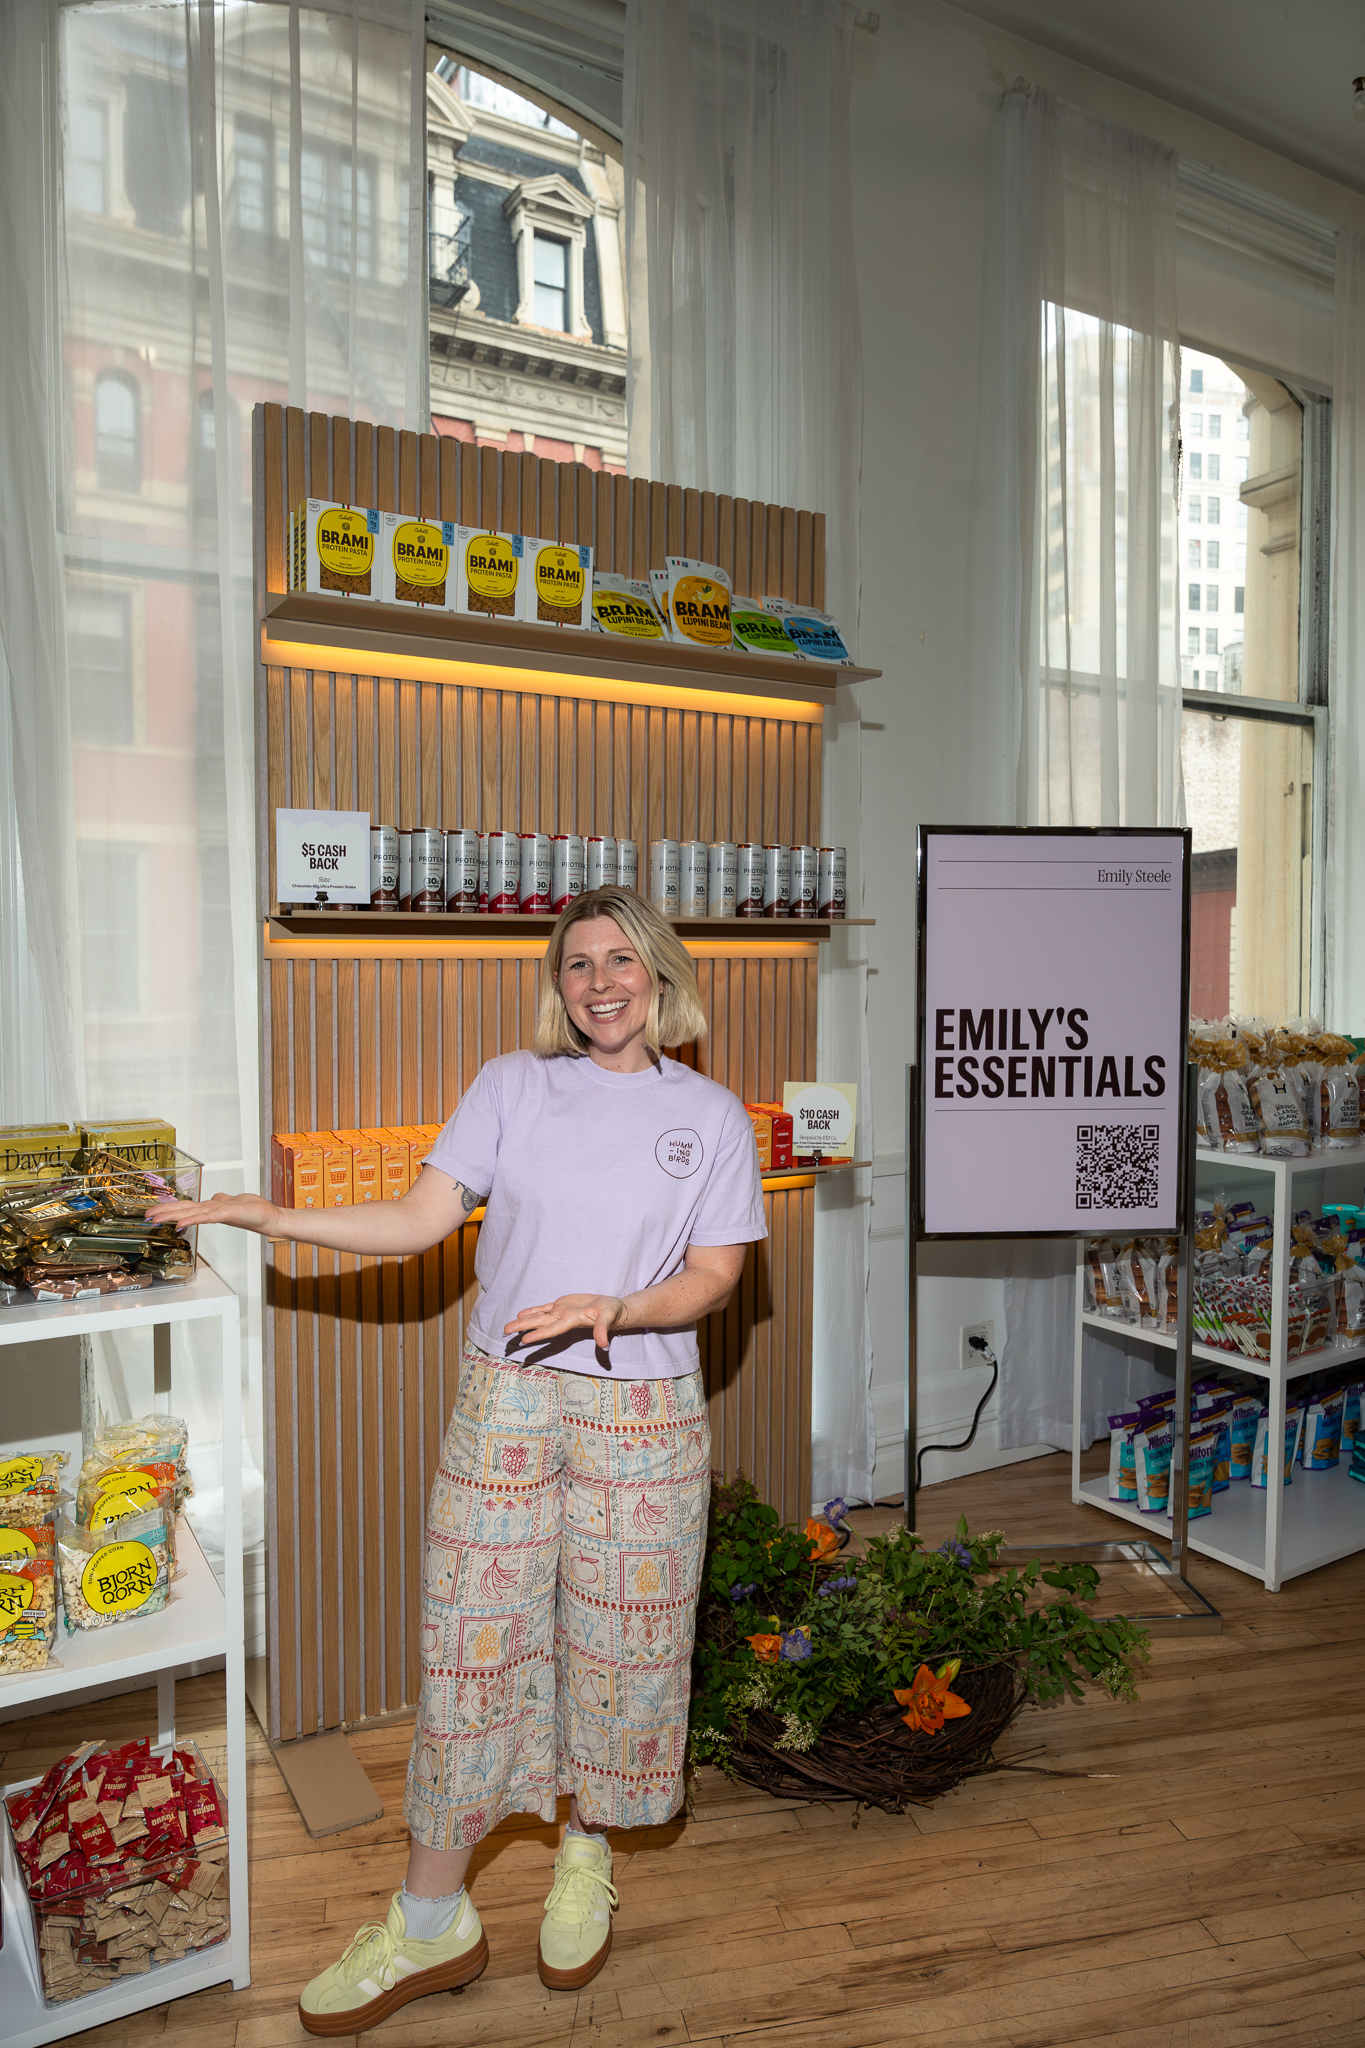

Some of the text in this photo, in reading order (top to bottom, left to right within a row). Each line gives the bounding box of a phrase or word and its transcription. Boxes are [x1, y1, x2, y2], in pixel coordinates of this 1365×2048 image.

[321, 529, 369, 550] BRAMI
[322, 543, 368, 557] PROTEIN PASTA
[397, 542, 444, 561] BRAMI
[398, 555, 442, 568] PROTEIN PASTA
[470, 555, 513, 573] BRAMI
[470, 568, 512, 579] PROTEIN PASTA
[539, 565, 580, 583] BRAMI
[540, 578, 563, 587] PROTEIN
[597, 604, 656, 620] BRAM
[675, 601, 730, 621] BRAM
[607, 615, 661, 627] LUPINI BEANS
[682, 617, 709, 627] LUPINI
[735, 623, 787, 635] BRAM
[788, 628, 841, 642] BRAM
[798, 638, 823, 646] LUPINI
[302, 842, 346, 857] $5 CASH
[309, 857, 339, 870] BACK
[1097, 869, 1171, 885] Emily Steele
[935, 1006, 1089, 1051] EMILY'S
[935, 1055, 1166, 1099] ESSENTIALS
[799, 1107, 839, 1120] $10 CASH
[807, 1120, 831, 1130] BACK
[105, 1138, 160, 1162] David
[669, 1140, 693, 1149] HUMM
[4, 1145, 63, 1171] David
[668, 1154, 690, 1166] BIRDS
[300, 1175, 317, 1183] SLEEP
[330, 1173, 346, 1181] SLEEP
[359, 1170, 375, 1179] SLEEP
[388, 1168, 403, 1177] SLEEP
[1233, 1405, 1256, 1421] Milton's
[1147, 1432, 1172, 1452] Milton's
[27, 1561, 47, 1570] SPICY
[88, 1552, 108, 1585] SUN-POPPED
[108, 1545, 124, 1554] CORN
[97, 1556, 152, 1593] BJORN
[103, 1573, 154, 1604] QORN
[133, 1773, 157, 1781] TUYYO
[104, 1782, 127, 1790] TUYYO
[192, 1803, 216, 1816] TUYYO
[151, 1813, 176, 1827] TUYYO
[81, 1826, 107, 1840] TUYYO
[576, 1850, 597, 1860] adidas
